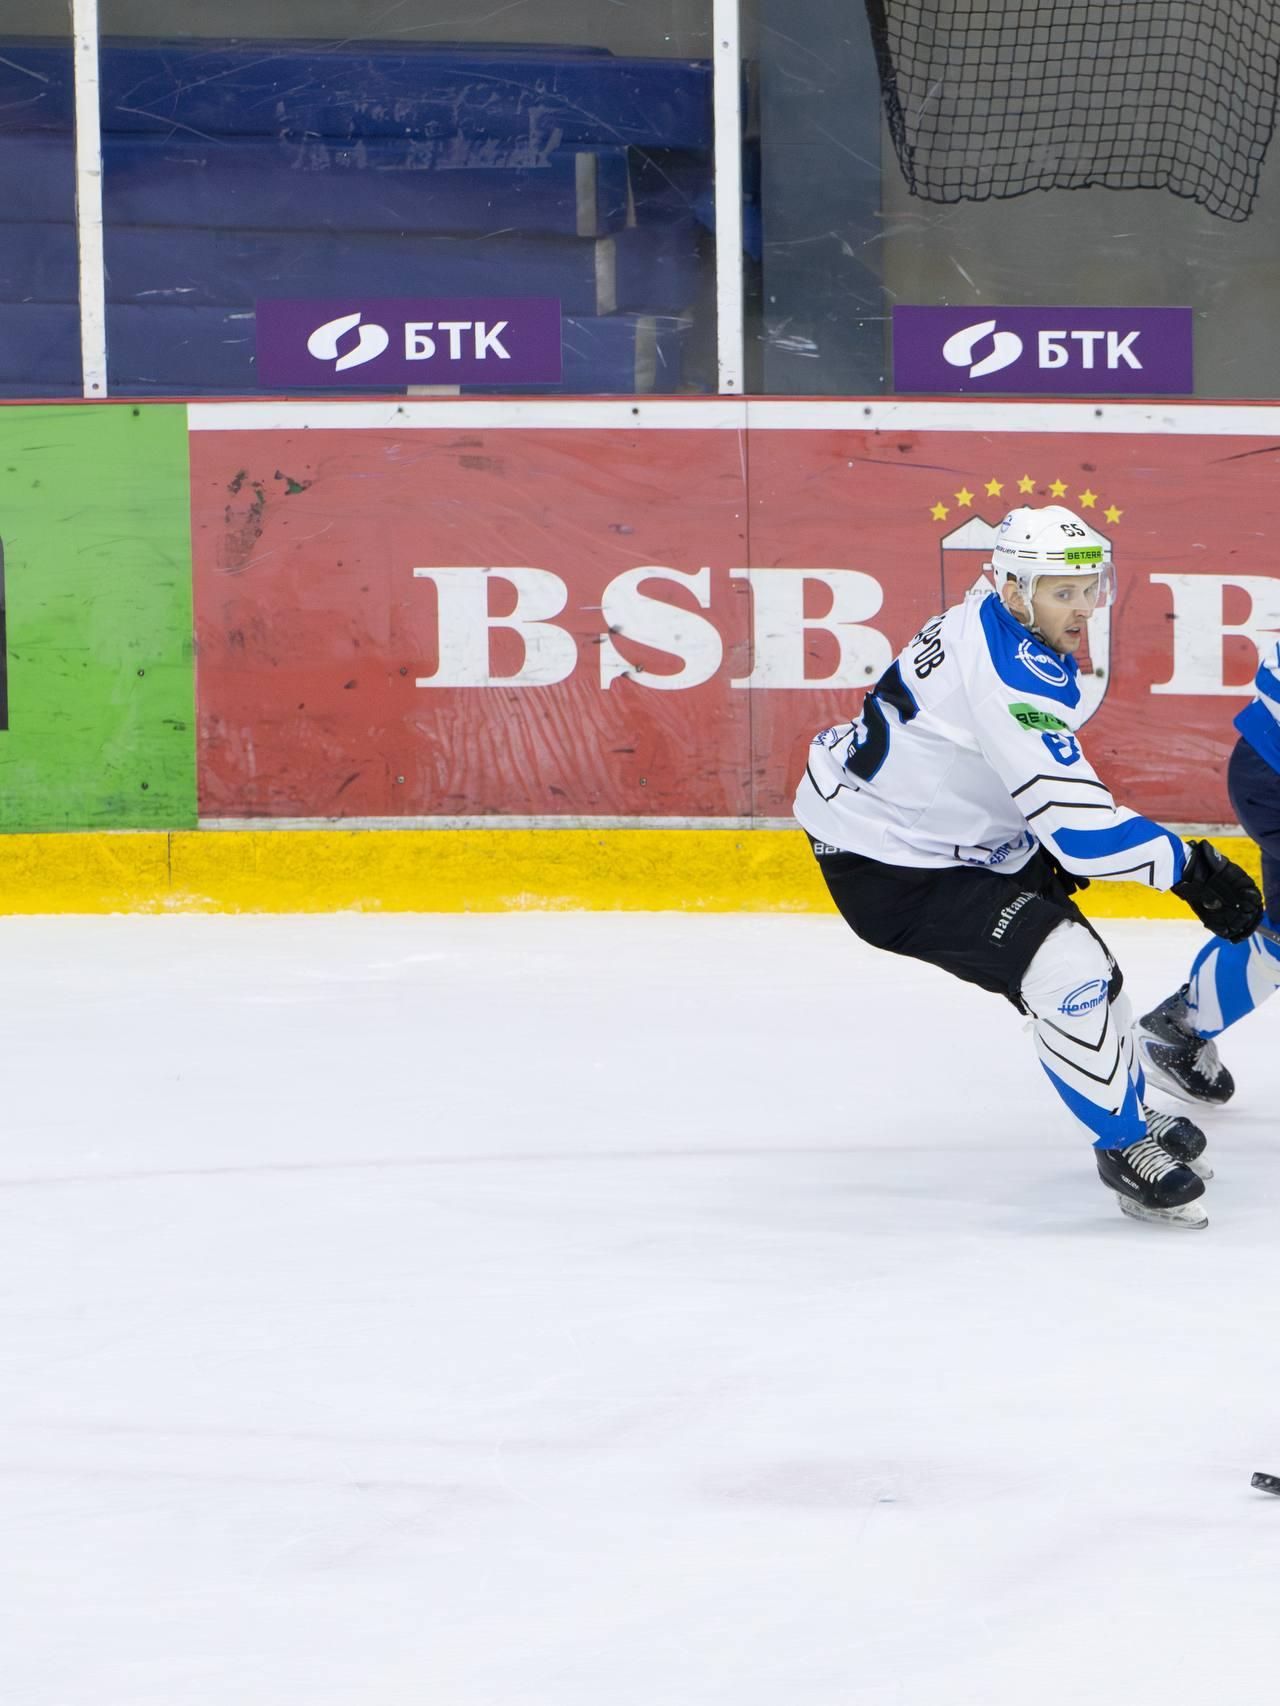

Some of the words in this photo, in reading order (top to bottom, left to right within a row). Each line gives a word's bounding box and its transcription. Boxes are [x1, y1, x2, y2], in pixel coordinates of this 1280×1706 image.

[404, 321, 512, 361] БТК
[1037, 330, 1144, 370] БТК
[1060, 523, 1086, 537] 65
[413, 566, 894, 691] BSB
